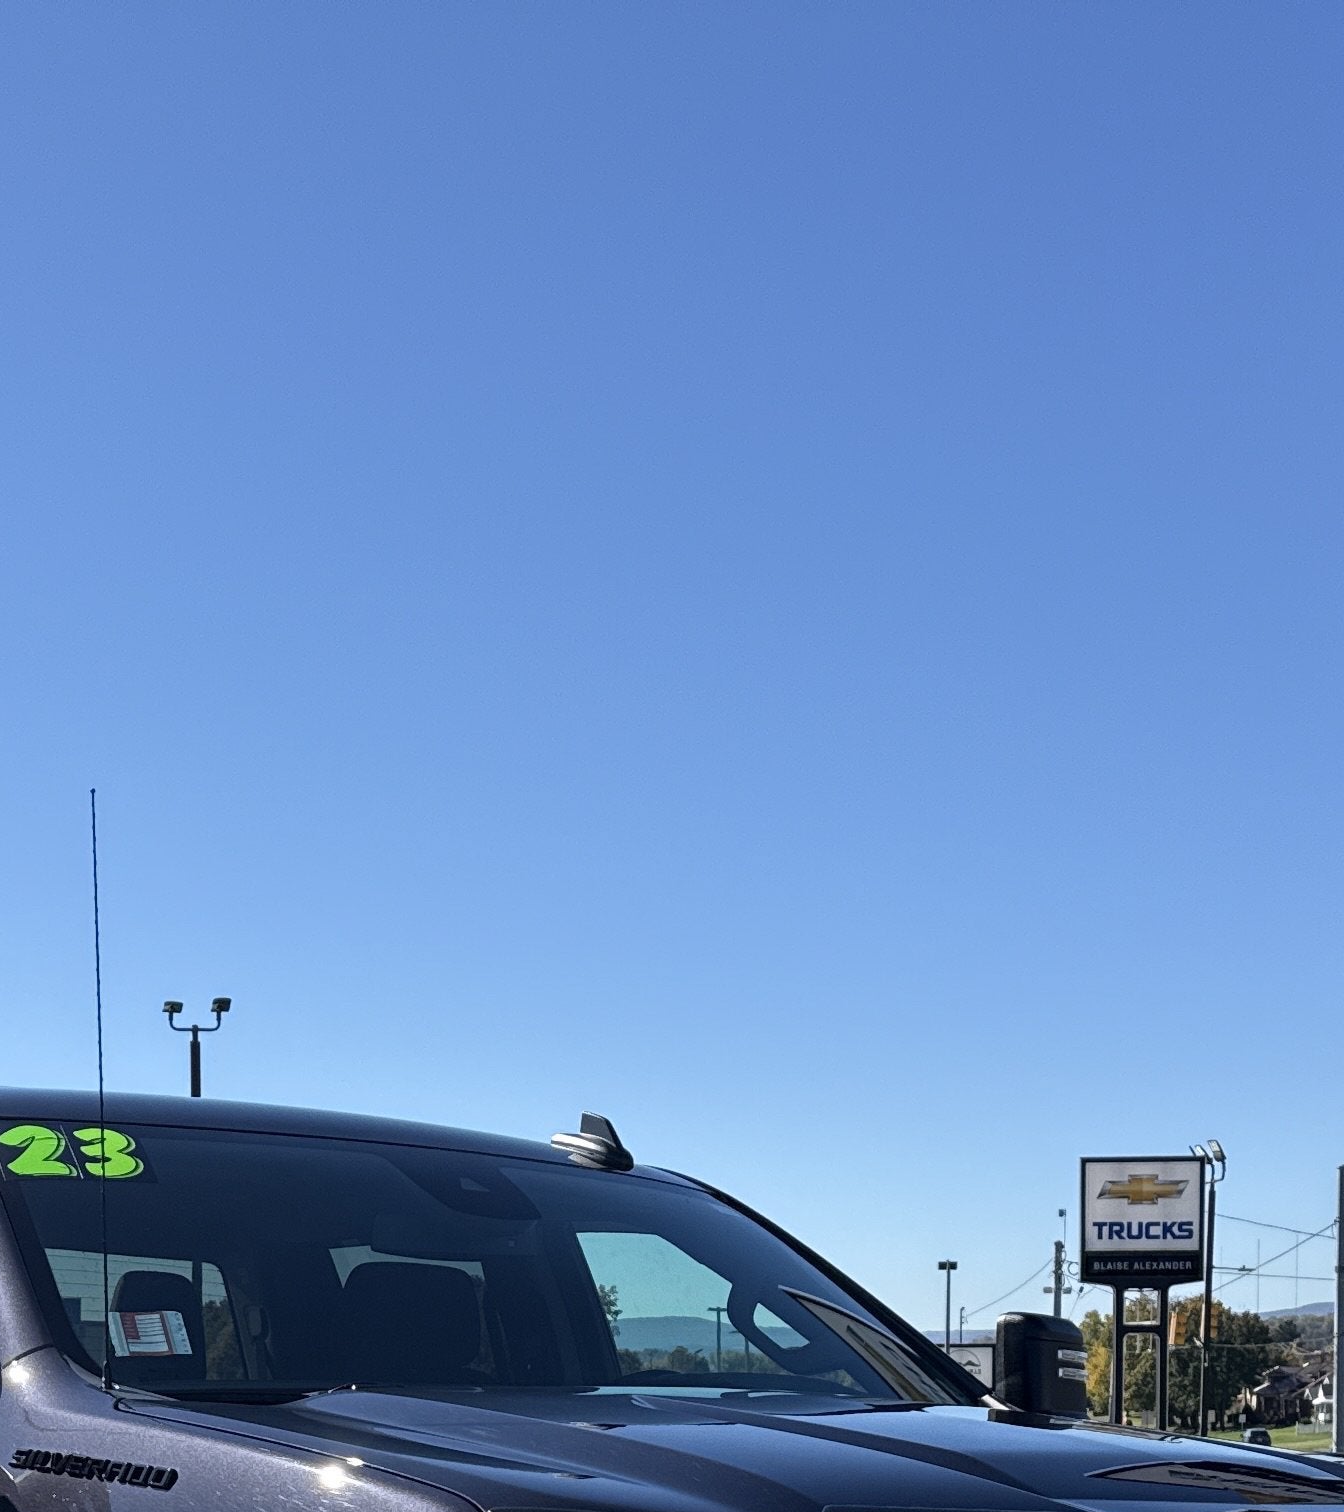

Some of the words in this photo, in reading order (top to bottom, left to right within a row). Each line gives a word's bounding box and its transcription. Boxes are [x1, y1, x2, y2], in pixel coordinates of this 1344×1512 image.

[1092, 1221, 1194, 1240] TRUCKS
[1093, 1261, 1129, 1271] BLAISE
[1133, 1260, 1192, 1270] ALEXANDER
[8, 1449, 179, 1492] SILVERADO
